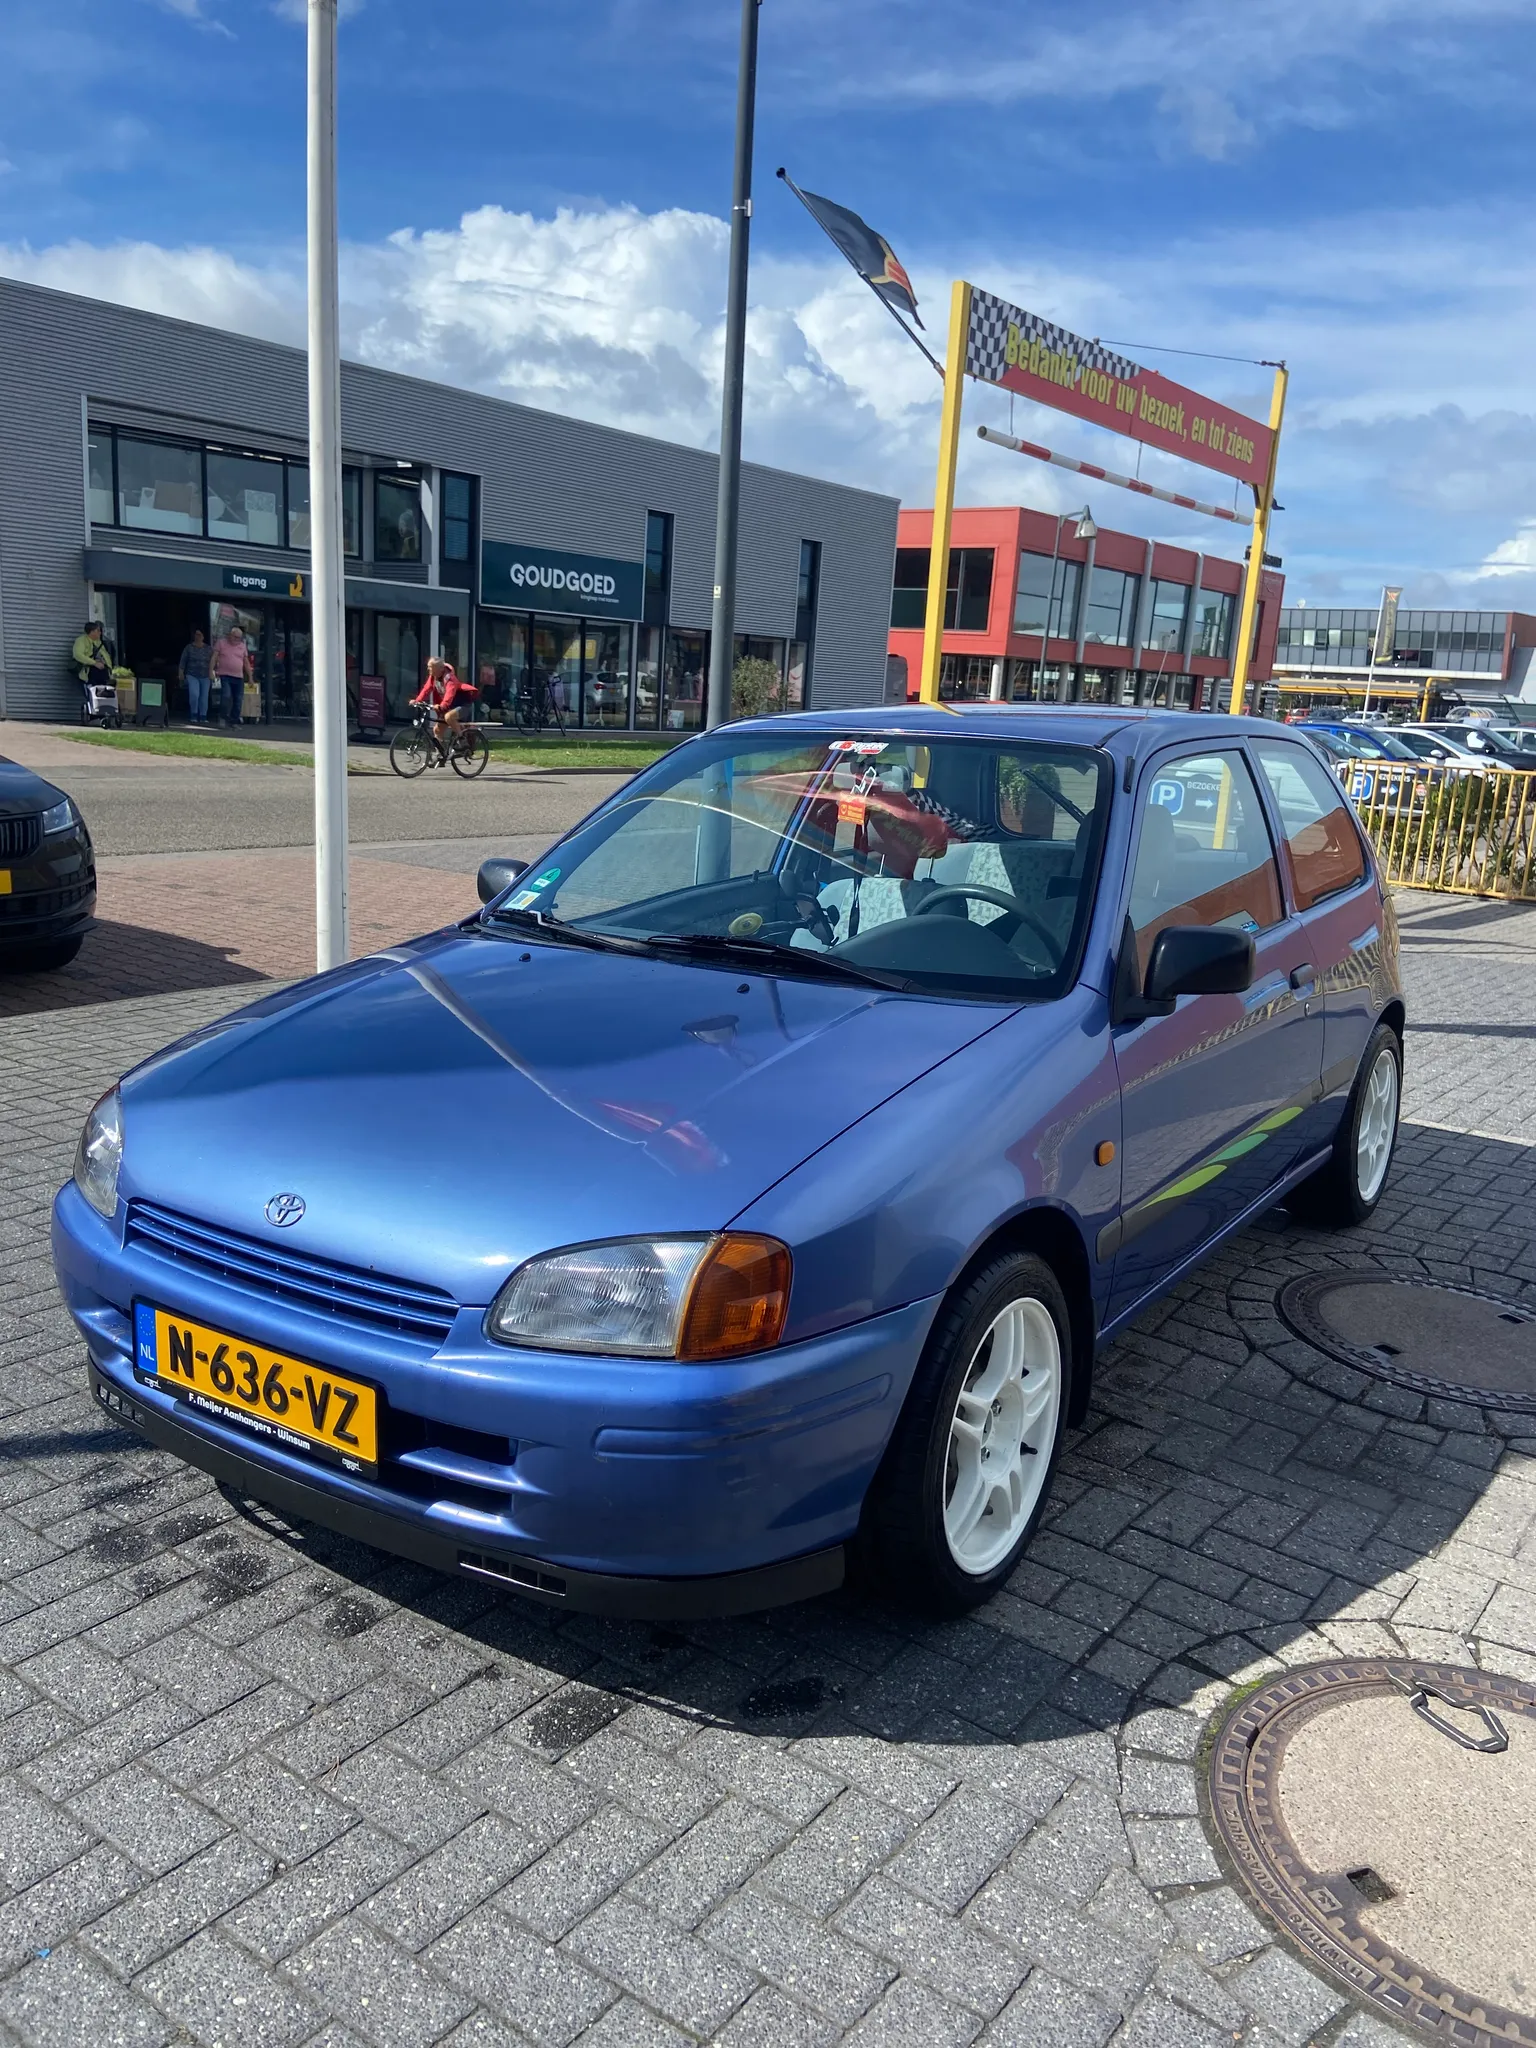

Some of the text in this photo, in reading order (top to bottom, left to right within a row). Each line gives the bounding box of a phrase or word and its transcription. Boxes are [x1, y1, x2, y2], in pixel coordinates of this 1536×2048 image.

[1005, 321, 1254, 464] Bedankt voor uw bezoek, en tot ziens
[232, 574, 267, 589] Ingang
[510, 563, 616, 595] GOUDGOED
[1186, 781, 1221, 792] BEZOEKE
[140, 1342, 155, 1361] NL
[168, 1324, 359, 1447] N-636-VZ
[188, 1392, 197, 1404] F.
[197, 1396, 223, 1414] Meijer
[223, 1403, 272, 1435] Aanhangers
[277, 1428, 310, 1450] Winsum
